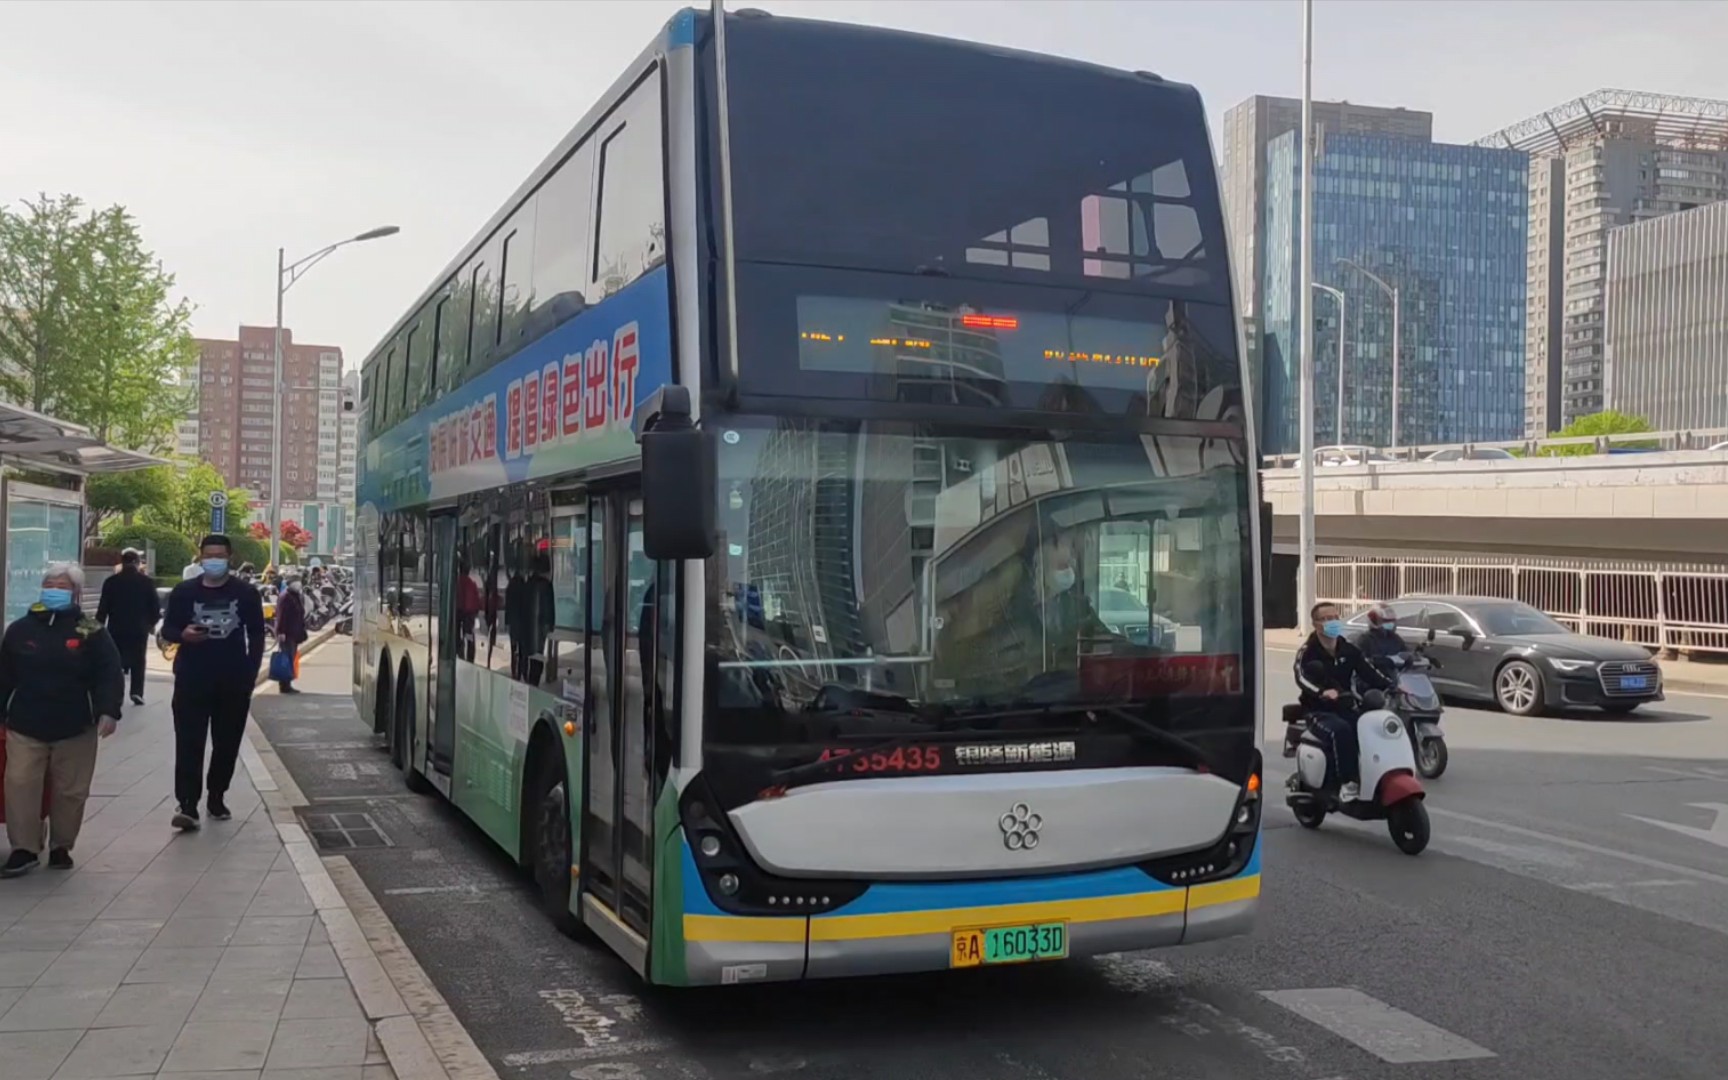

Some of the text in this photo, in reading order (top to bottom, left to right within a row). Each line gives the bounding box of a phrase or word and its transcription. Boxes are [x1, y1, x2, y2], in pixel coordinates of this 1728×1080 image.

[506, 324, 639, 456] 提倡绿色出行
